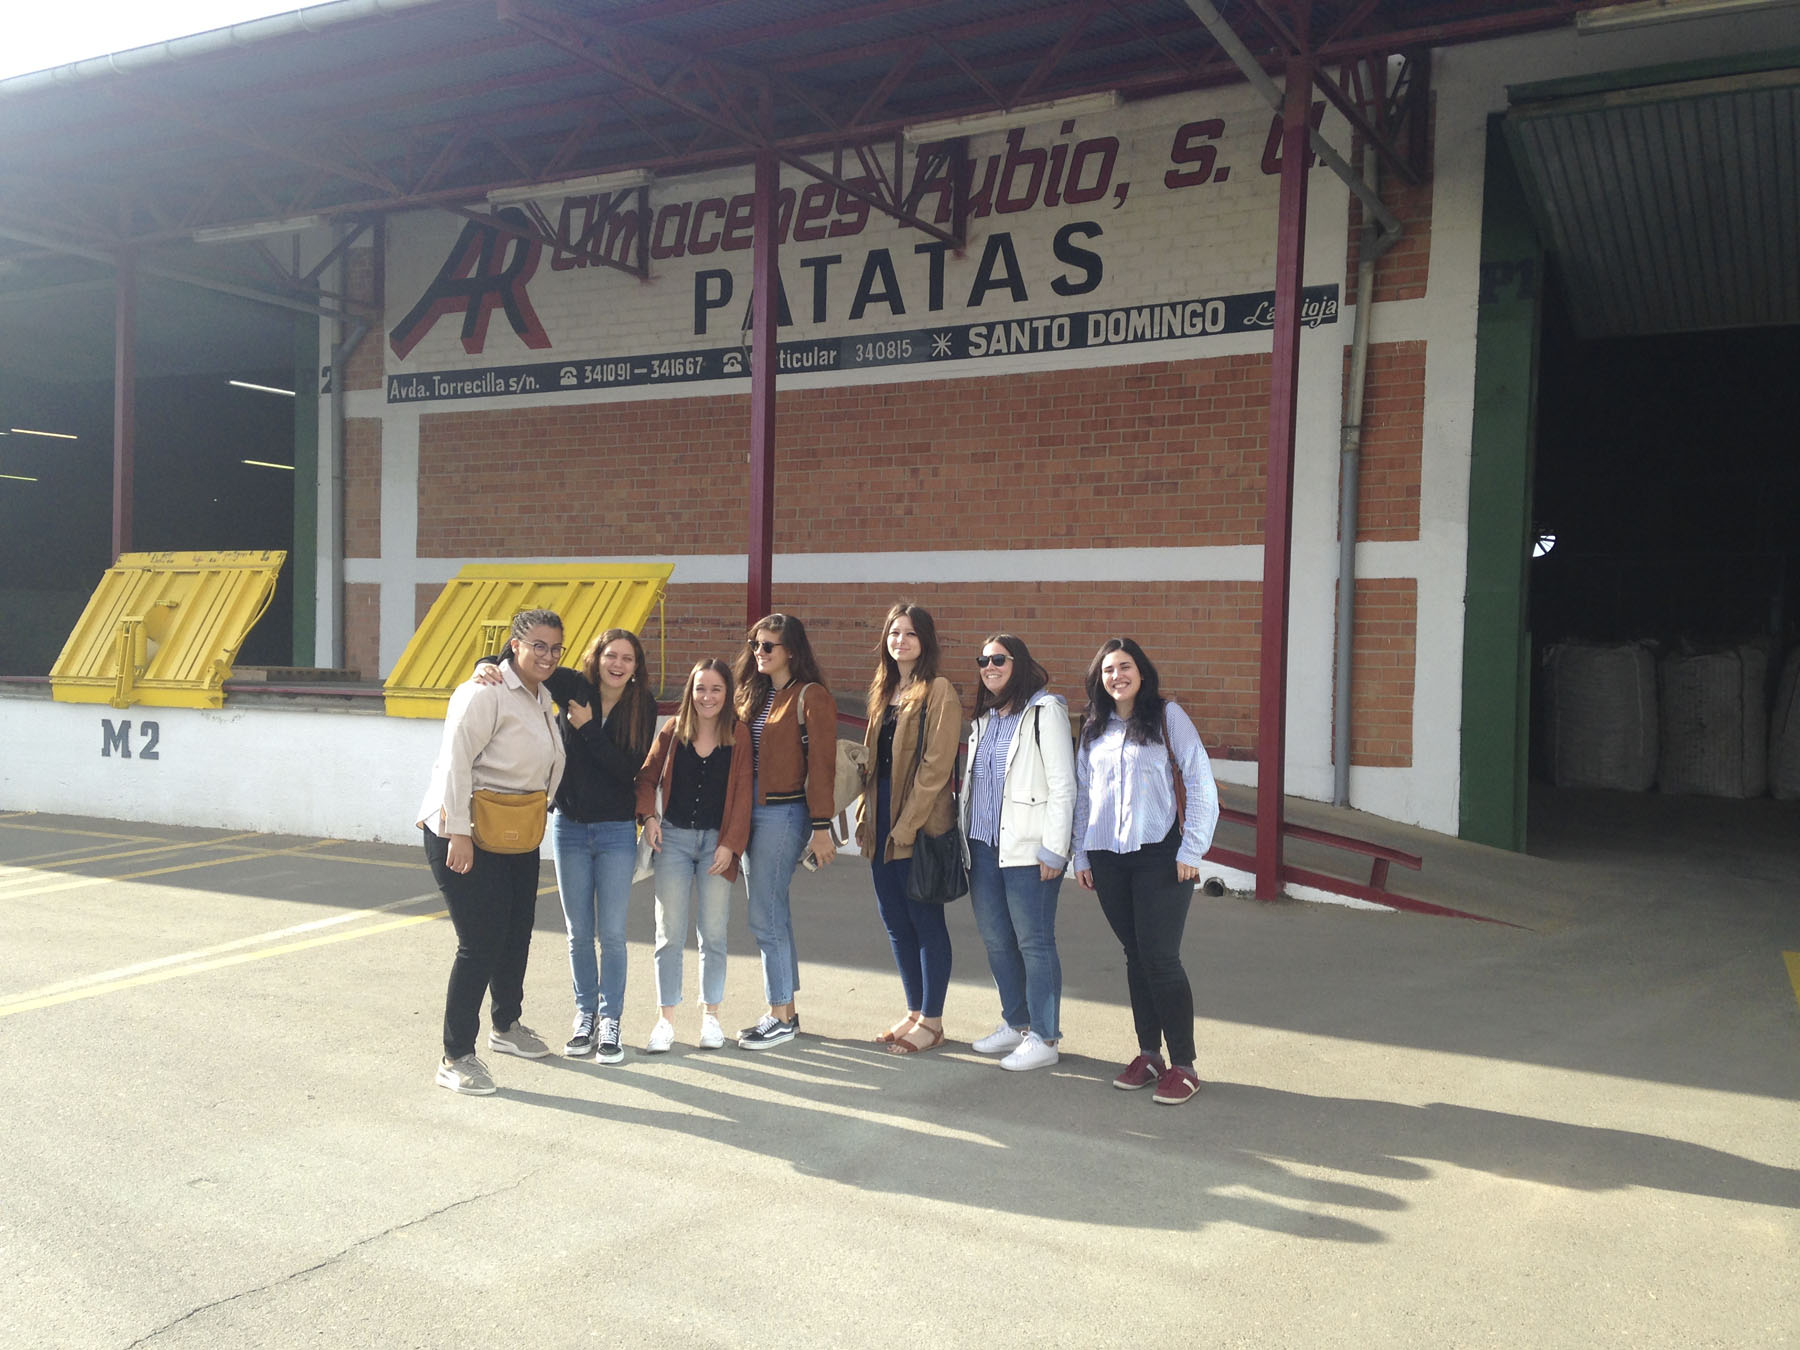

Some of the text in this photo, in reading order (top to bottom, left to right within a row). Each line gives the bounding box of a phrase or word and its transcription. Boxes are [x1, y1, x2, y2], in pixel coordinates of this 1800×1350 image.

[390, 378, 430, 399] Avda.
[433, 372, 505, 396] Torrecilla
[509, 373, 540, 393] s/n.
[750, 346, 837, 370] ticular
[856, 339, 912, 362] 340815
[968, 317, 1070, 357] SANTO
[1087, 300, 1226, 346] DOMINGO
[1301, 295, 1337, 328] ioja
